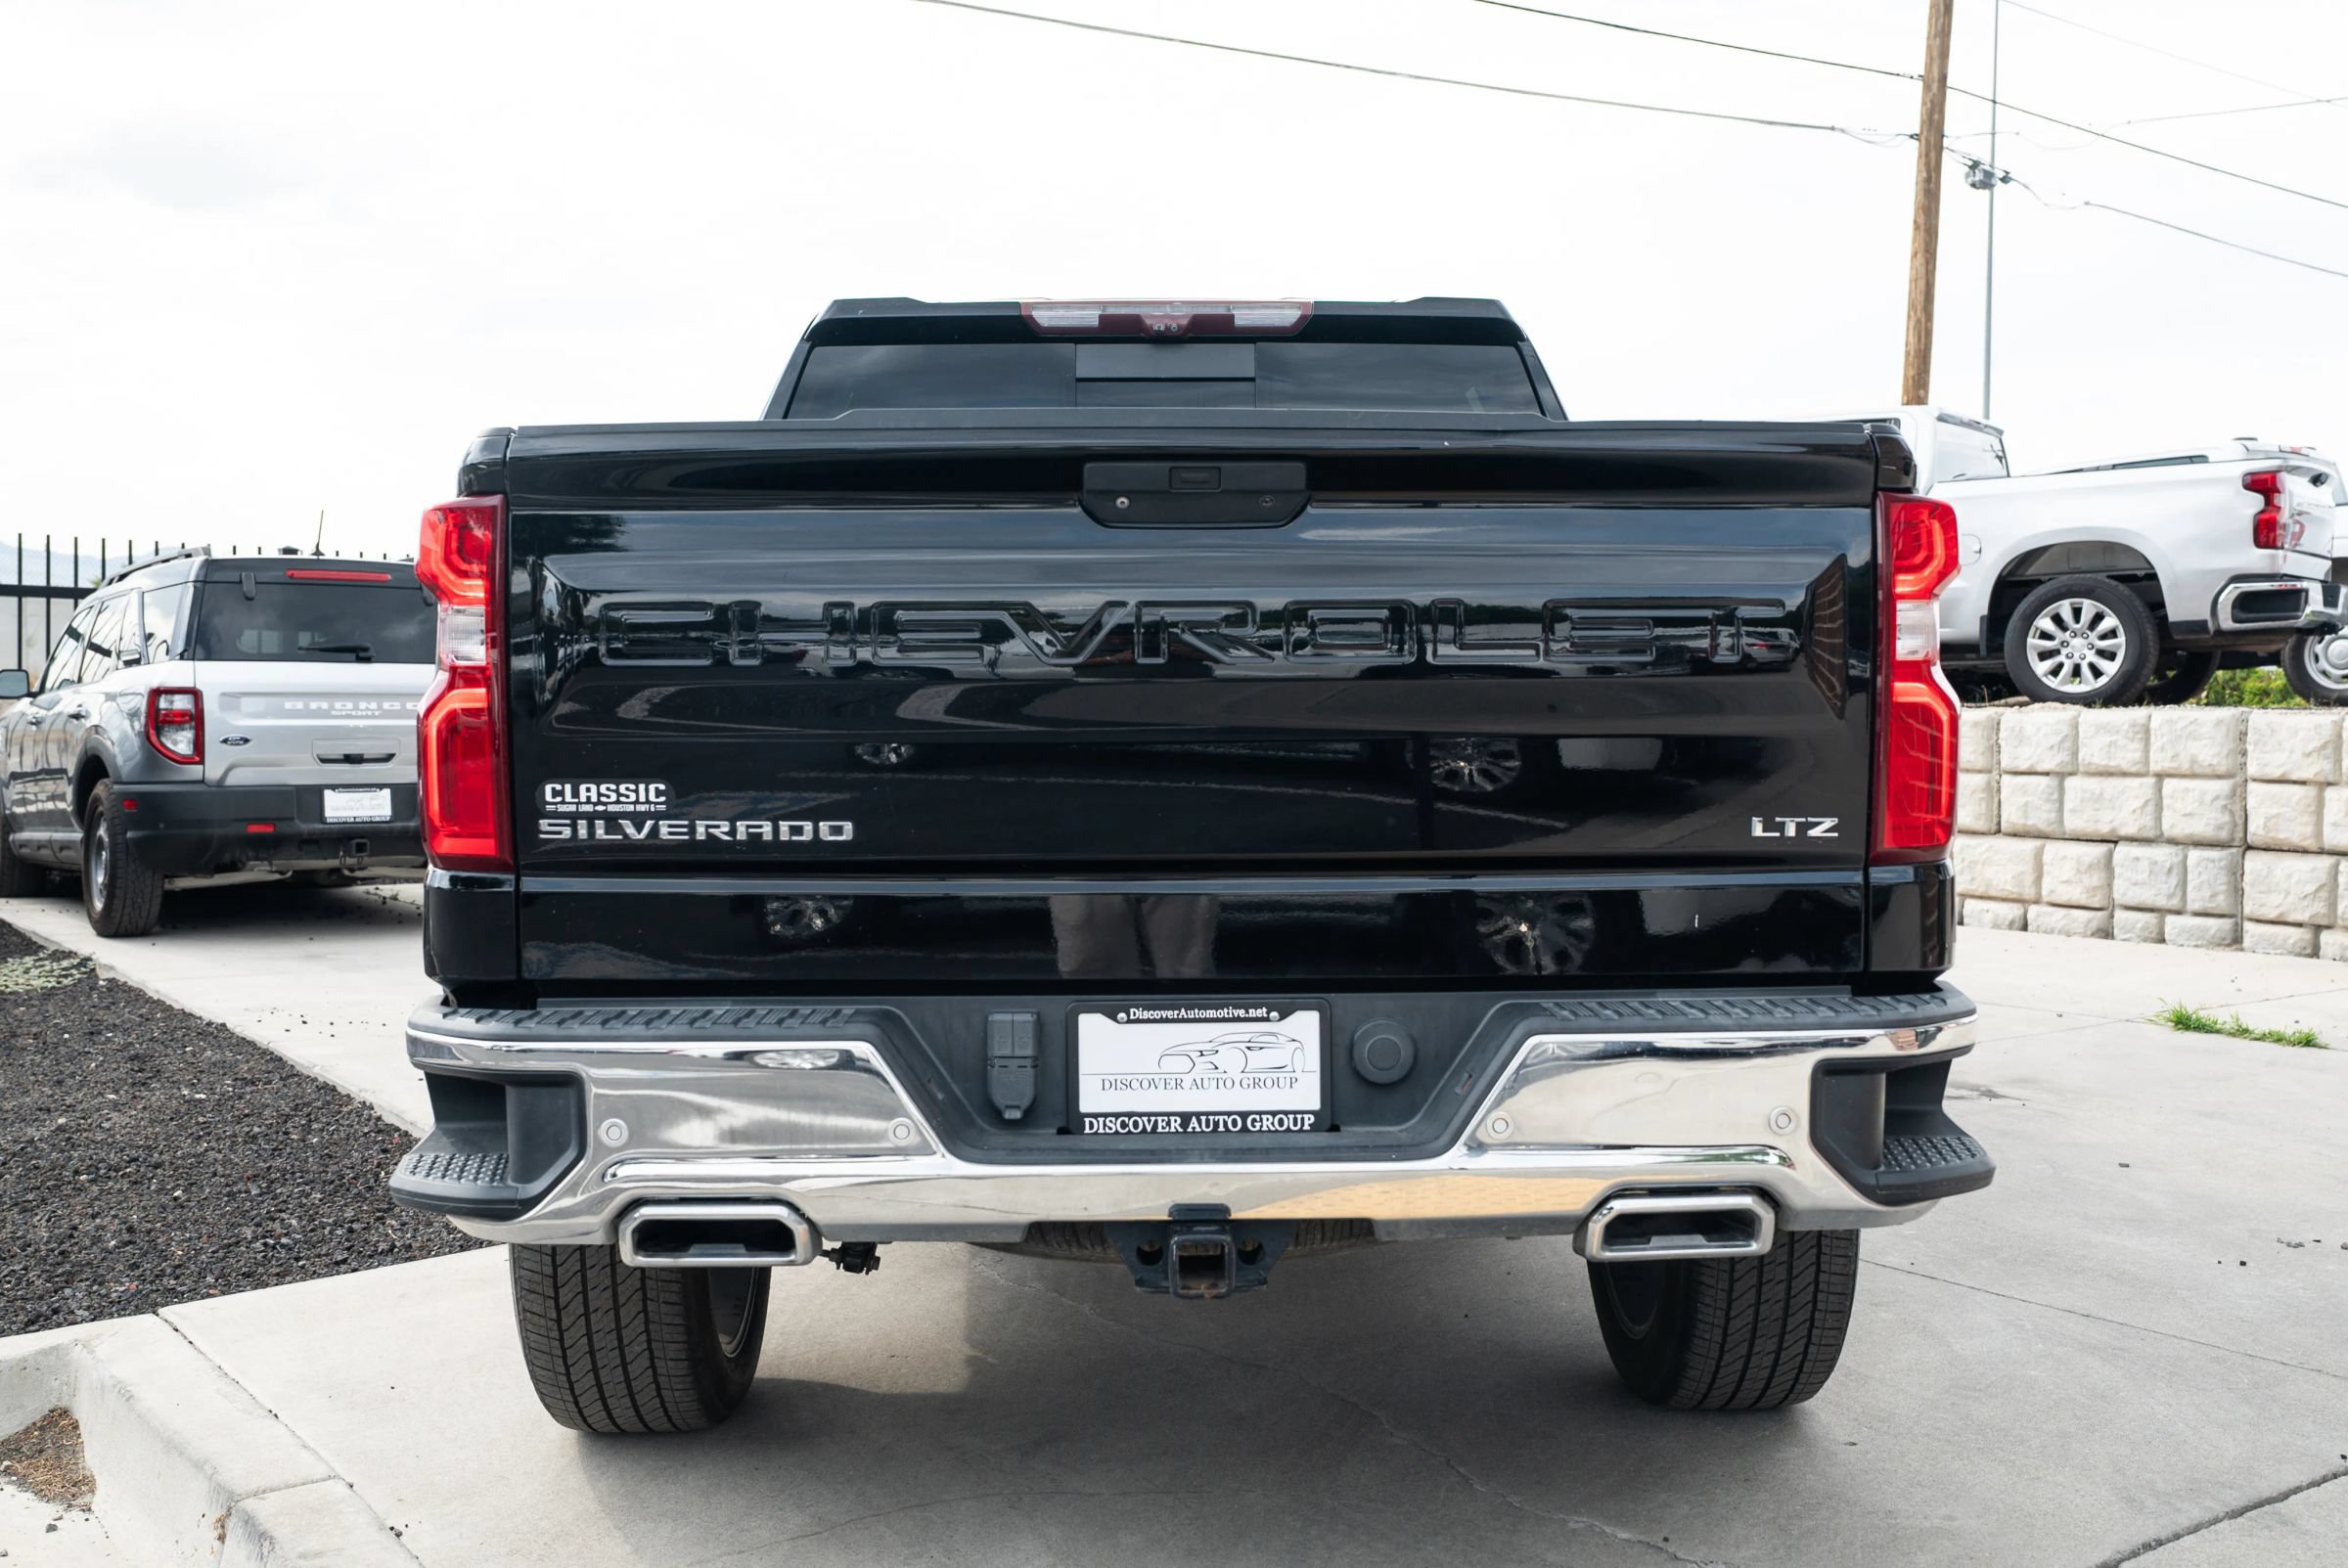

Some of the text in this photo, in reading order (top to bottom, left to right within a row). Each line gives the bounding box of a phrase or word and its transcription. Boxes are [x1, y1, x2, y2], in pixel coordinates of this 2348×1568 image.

[600, 598, 1786, 666] CHEVROLET
[545, 784, 666, 802] CLASSIC
[538, 820, 853, 840] SILVERADO
[1751, 816, 1839, 836] LTZ
[1129, 1007, 1268, 1019] DiscoverAutomotive.net
[1101, 1076, 1298, 1091] DISCOVER AUTO GROUP
[1083, 1113, 1315, 1134] DISCOVER AUTO GROUP
